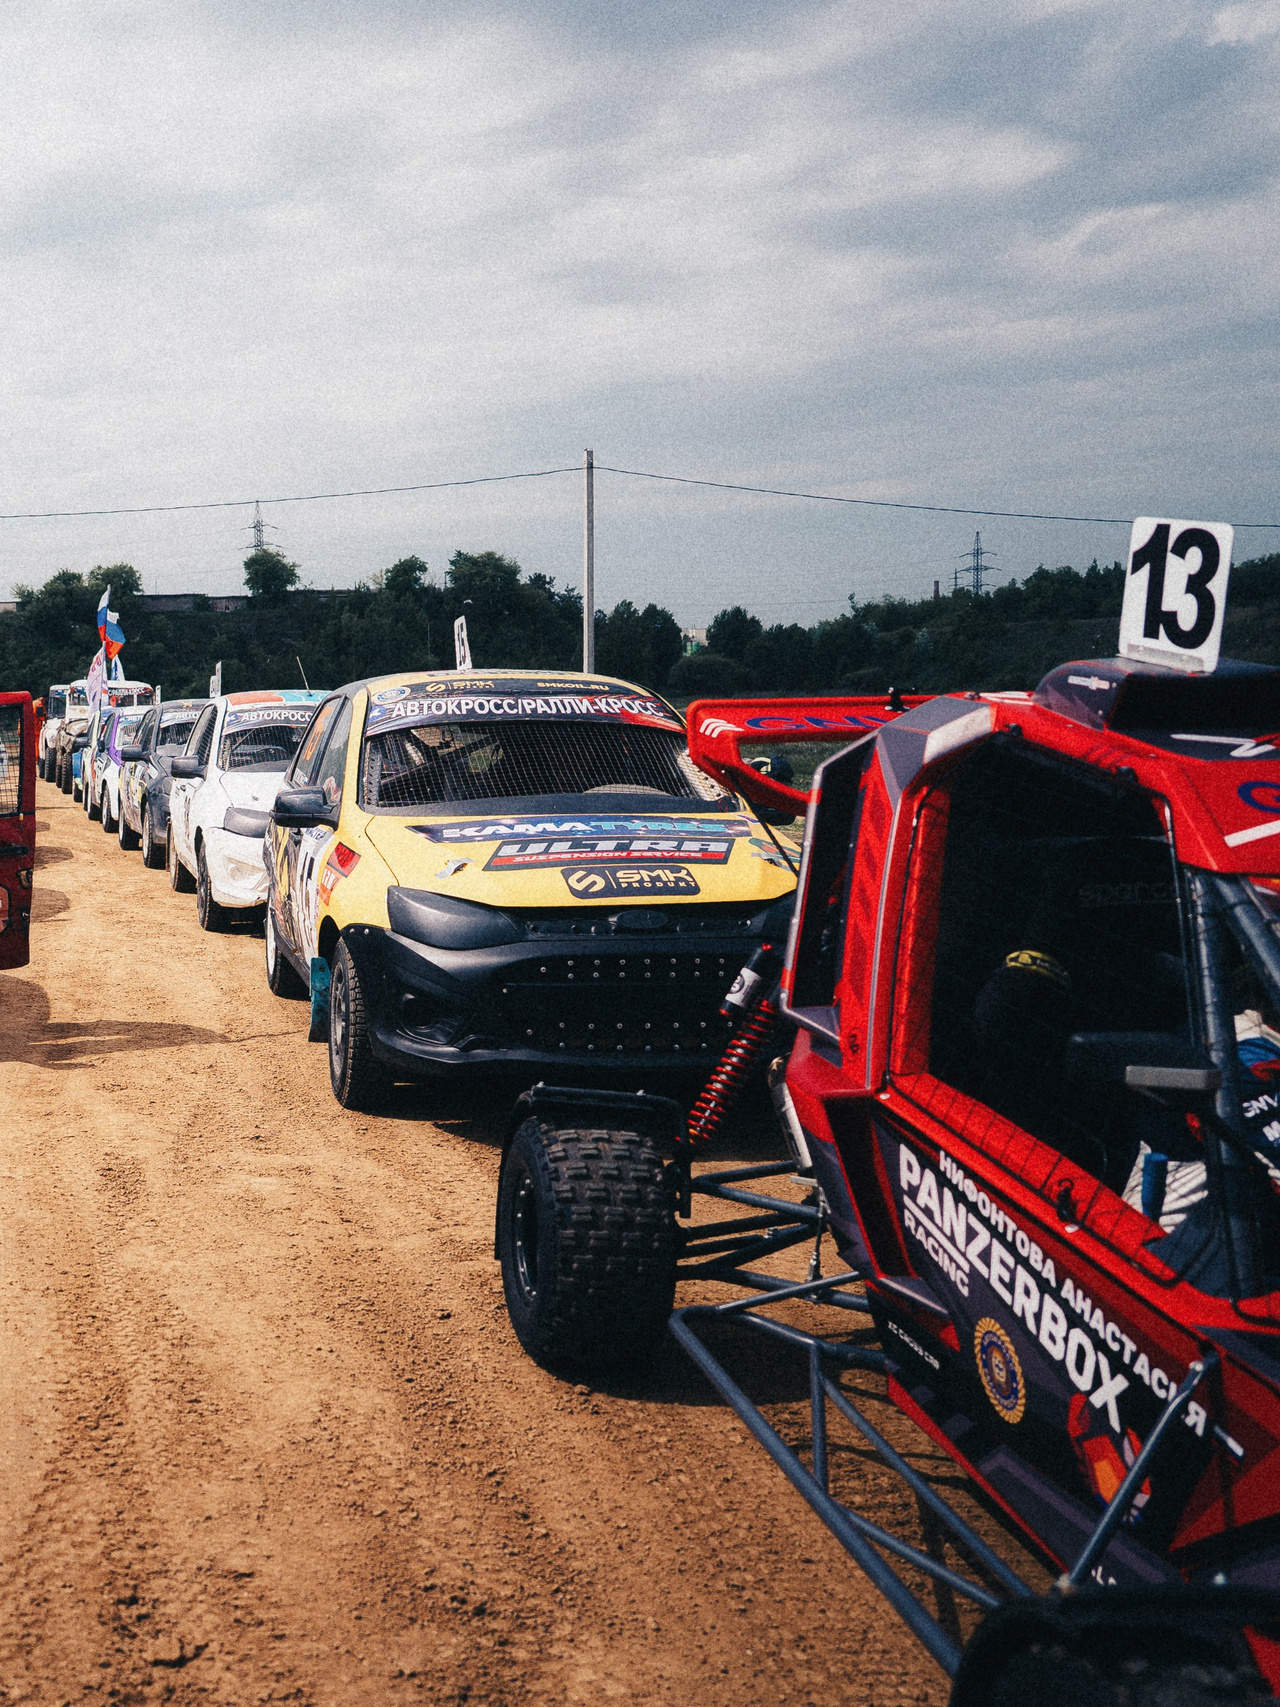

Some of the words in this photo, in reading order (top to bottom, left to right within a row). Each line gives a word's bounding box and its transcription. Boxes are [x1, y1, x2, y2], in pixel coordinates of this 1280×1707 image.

[1130, 523, 1221, 650] 13
[536, 682, 610, 691] SMKOIL.RU
[175, 711, 199, 719] АВТО
[241, 710, 313, 722] АВТОКРОСС
[391, 698, 665, 718] АВТОКРОСС/РАЛЛИ-КРОСС
[442, 821, 595, 838] KAMA
[497, 839, 729, 857] ULTRA
[512, 851, 627, 863] SUSPENSION
[629, 850, 703, 858] SERVICE
[616, 869, 695, 883] SMK
[621, 881, 696, 889] PRODUKT
[939, 1150, 1057, 1288] НИФОНТОВА
[903, 1208, 970, 1298] RACING
[899, 1143, 1130, 1434] PANZERBOX
